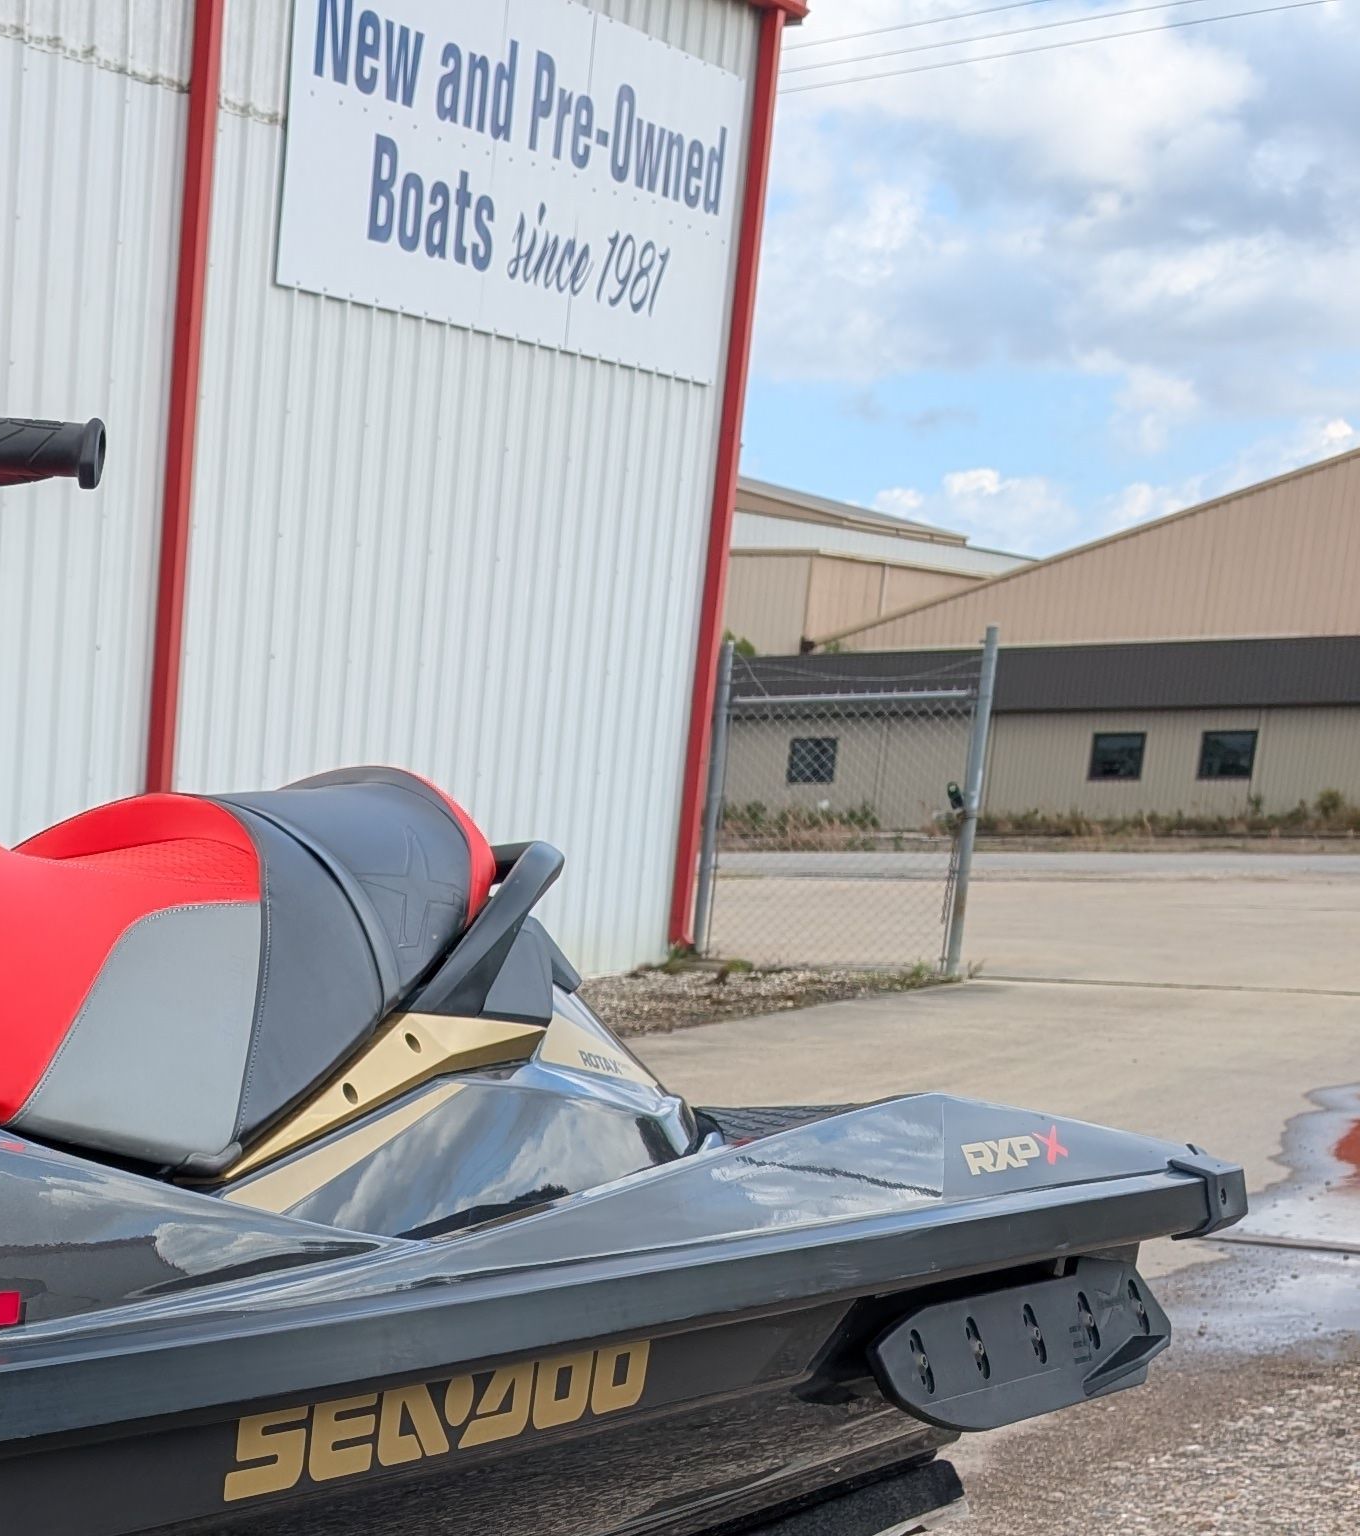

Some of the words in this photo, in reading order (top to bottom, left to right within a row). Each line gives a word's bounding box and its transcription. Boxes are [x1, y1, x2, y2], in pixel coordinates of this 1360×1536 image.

[313, 0, 425, 108] New
[436, 38, 519, 142] and
[528, 49, 727, 216] Pre-Owned
[367, 133, 495, 272] Boats
[507, 202, 594, 297] since
[596, 230, 670, 317] 1981
[578, 1050, 623, 1075] ROTAX
